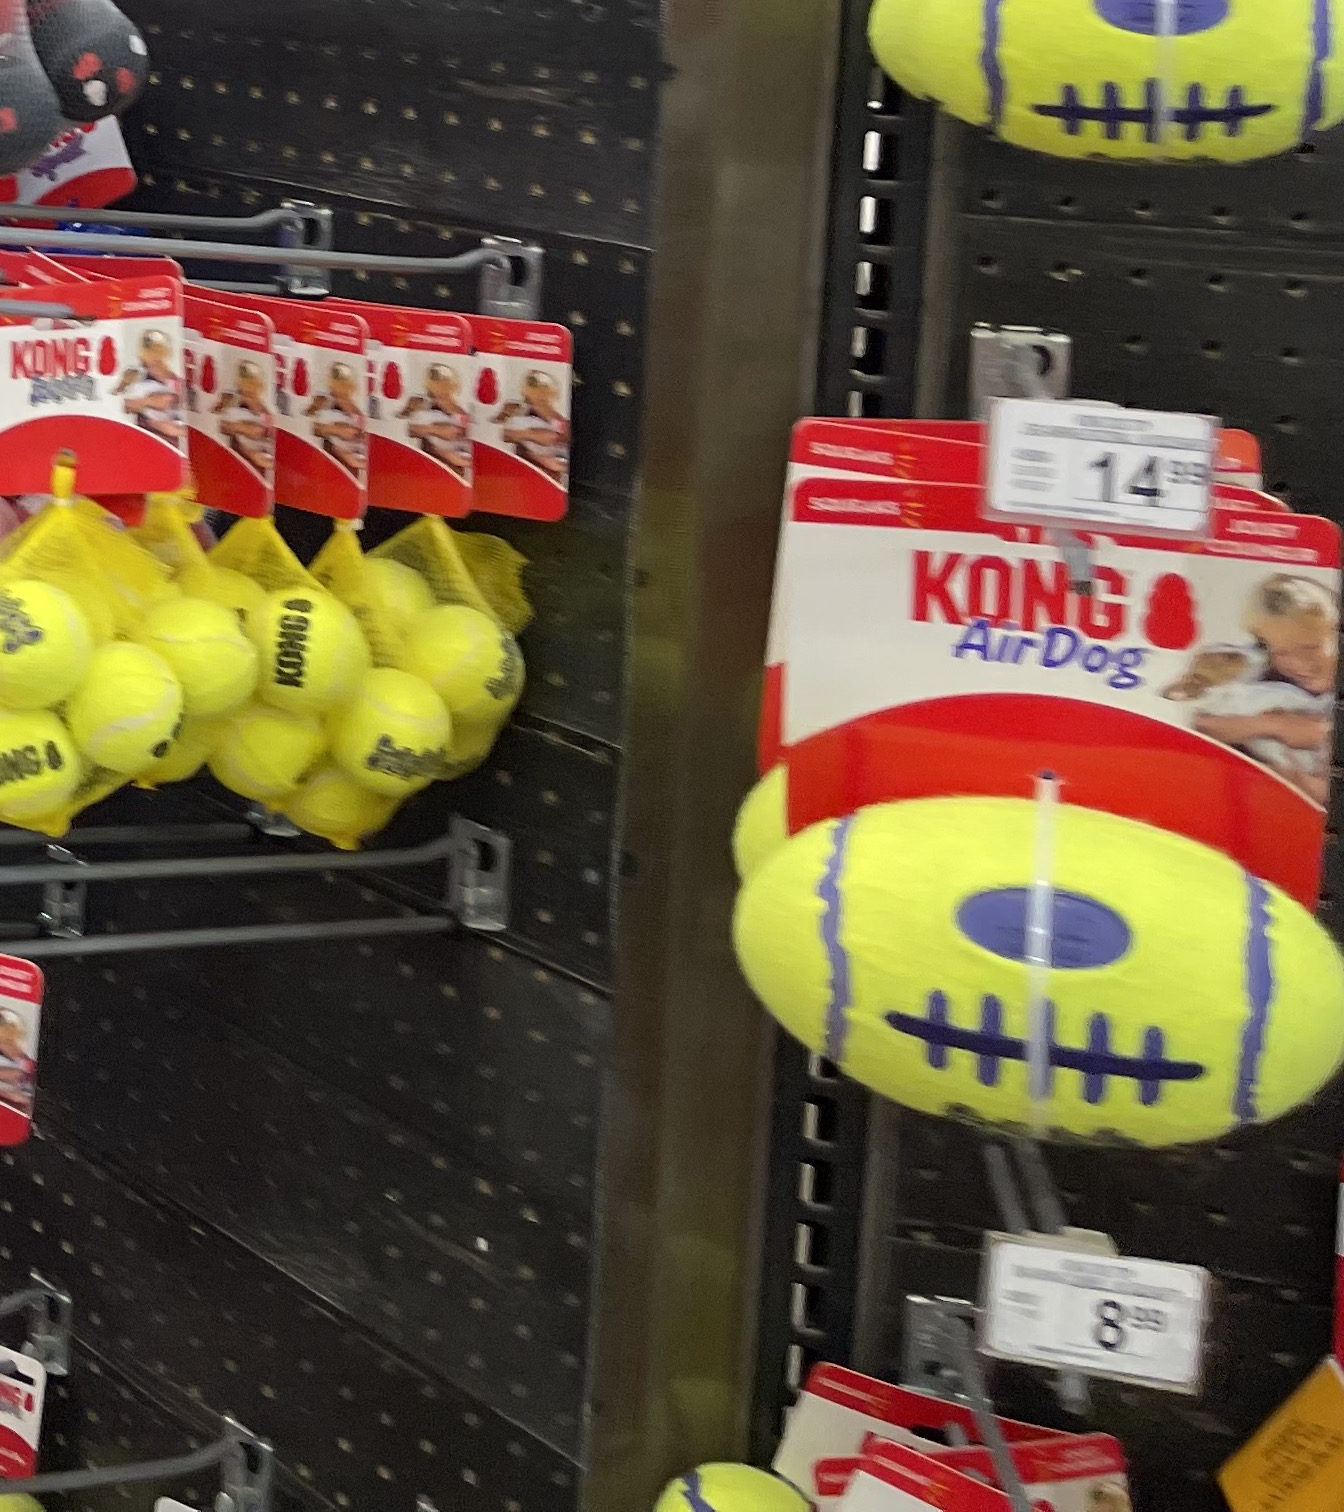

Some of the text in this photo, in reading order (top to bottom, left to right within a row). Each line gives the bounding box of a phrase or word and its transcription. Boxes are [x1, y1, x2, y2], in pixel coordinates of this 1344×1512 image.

[9, 336, 97, 380] KONG
[910, 548, 1130, 642] KONG
[275, 614, 312, 688] KONG
